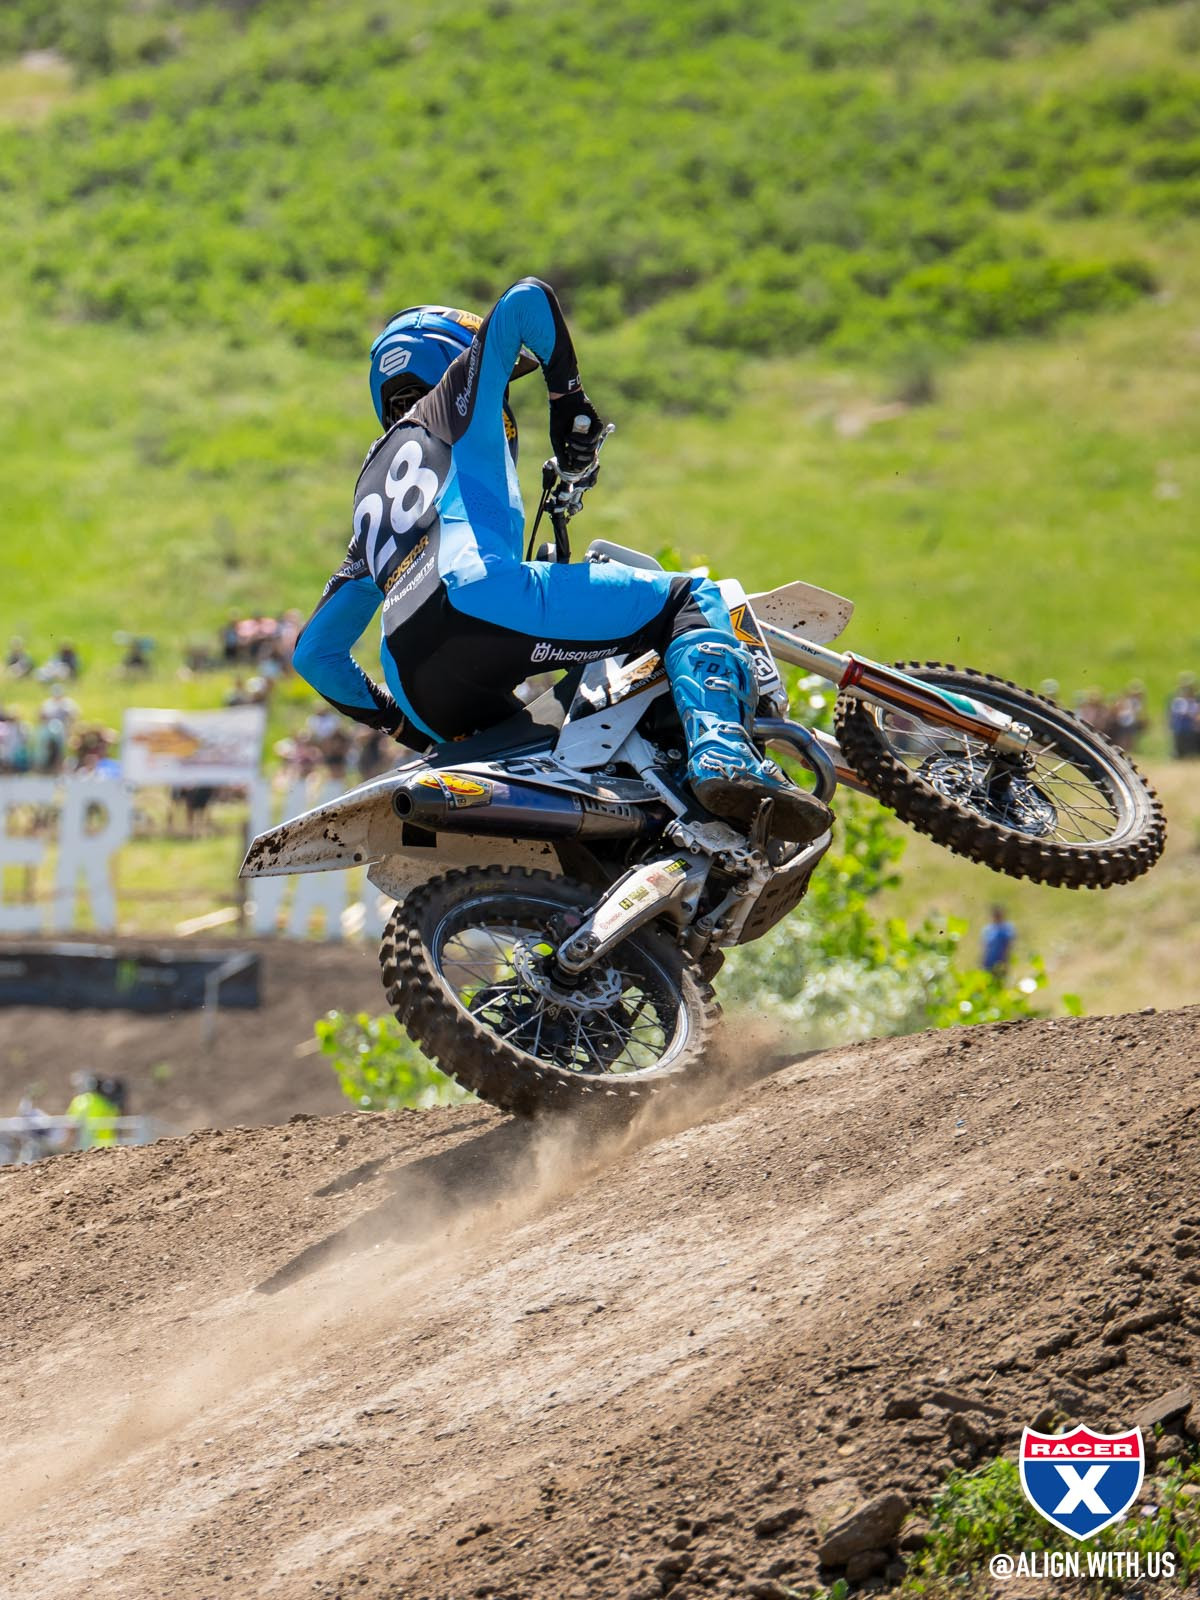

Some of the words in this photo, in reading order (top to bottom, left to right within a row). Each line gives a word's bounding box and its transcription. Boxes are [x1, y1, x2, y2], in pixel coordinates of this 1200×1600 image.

[353, 440, 439, 583] 28
[390, 556, 436, 607] Husqvarna
[548, 647, 618, 662] Husqvarna
[693, 660, 732, 678] FOX
